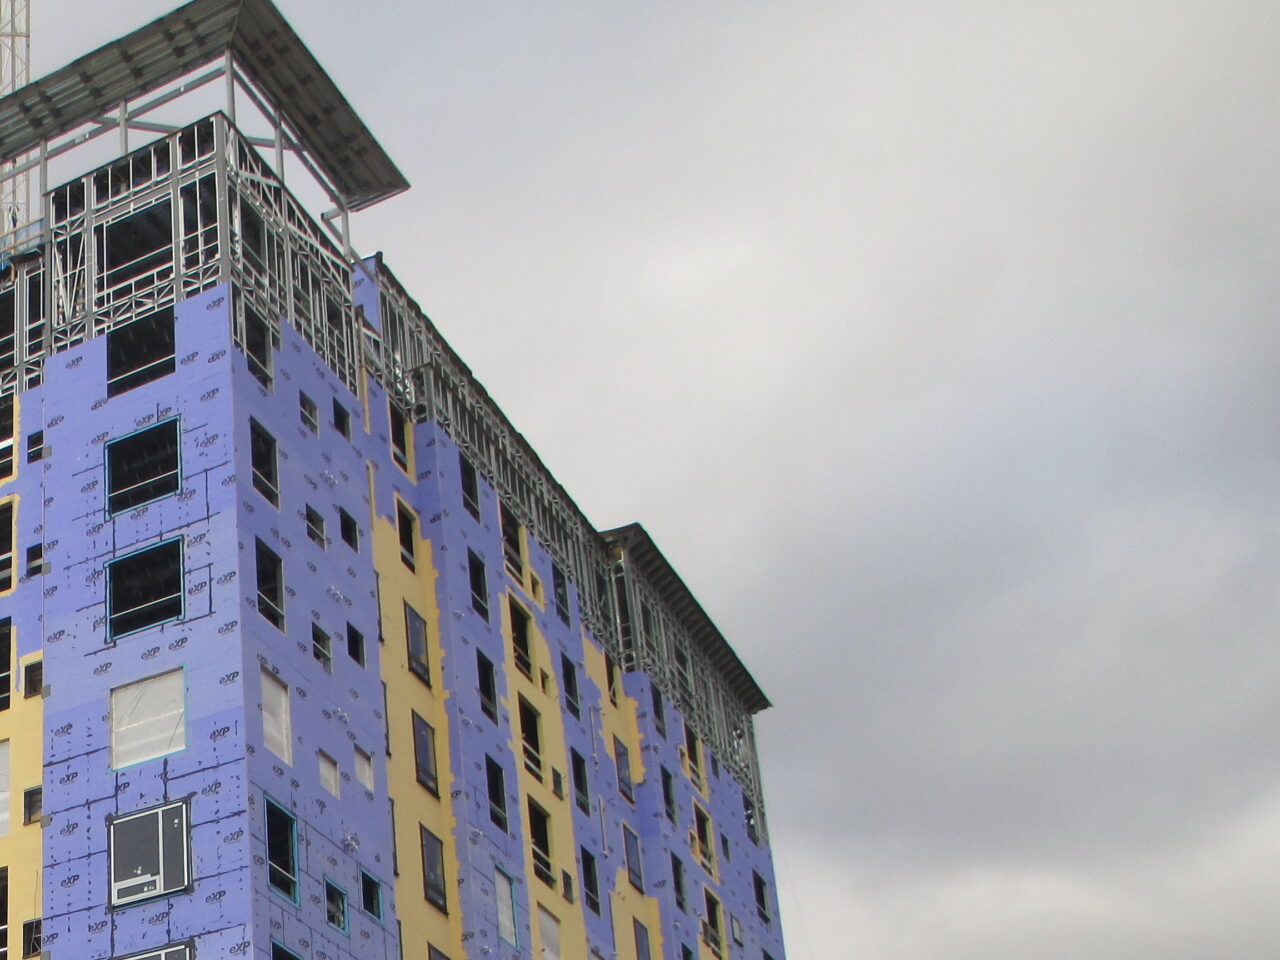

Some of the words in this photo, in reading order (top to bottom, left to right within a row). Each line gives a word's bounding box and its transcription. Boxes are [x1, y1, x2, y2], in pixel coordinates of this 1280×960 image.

[60, 772, 78, 784] eXP
[202, 782, 220, 795] eXP
[60, 823, 78, 835] eXP
[223, 830, 243, 843] eXP
[61, 875, 79, 887] eXP
[206, 890, 226, 903] eXP
[149, 912, 168, 924] eXP
[88, 921, 107, 932] eXP
[230, 941, 250, 953] eXP
